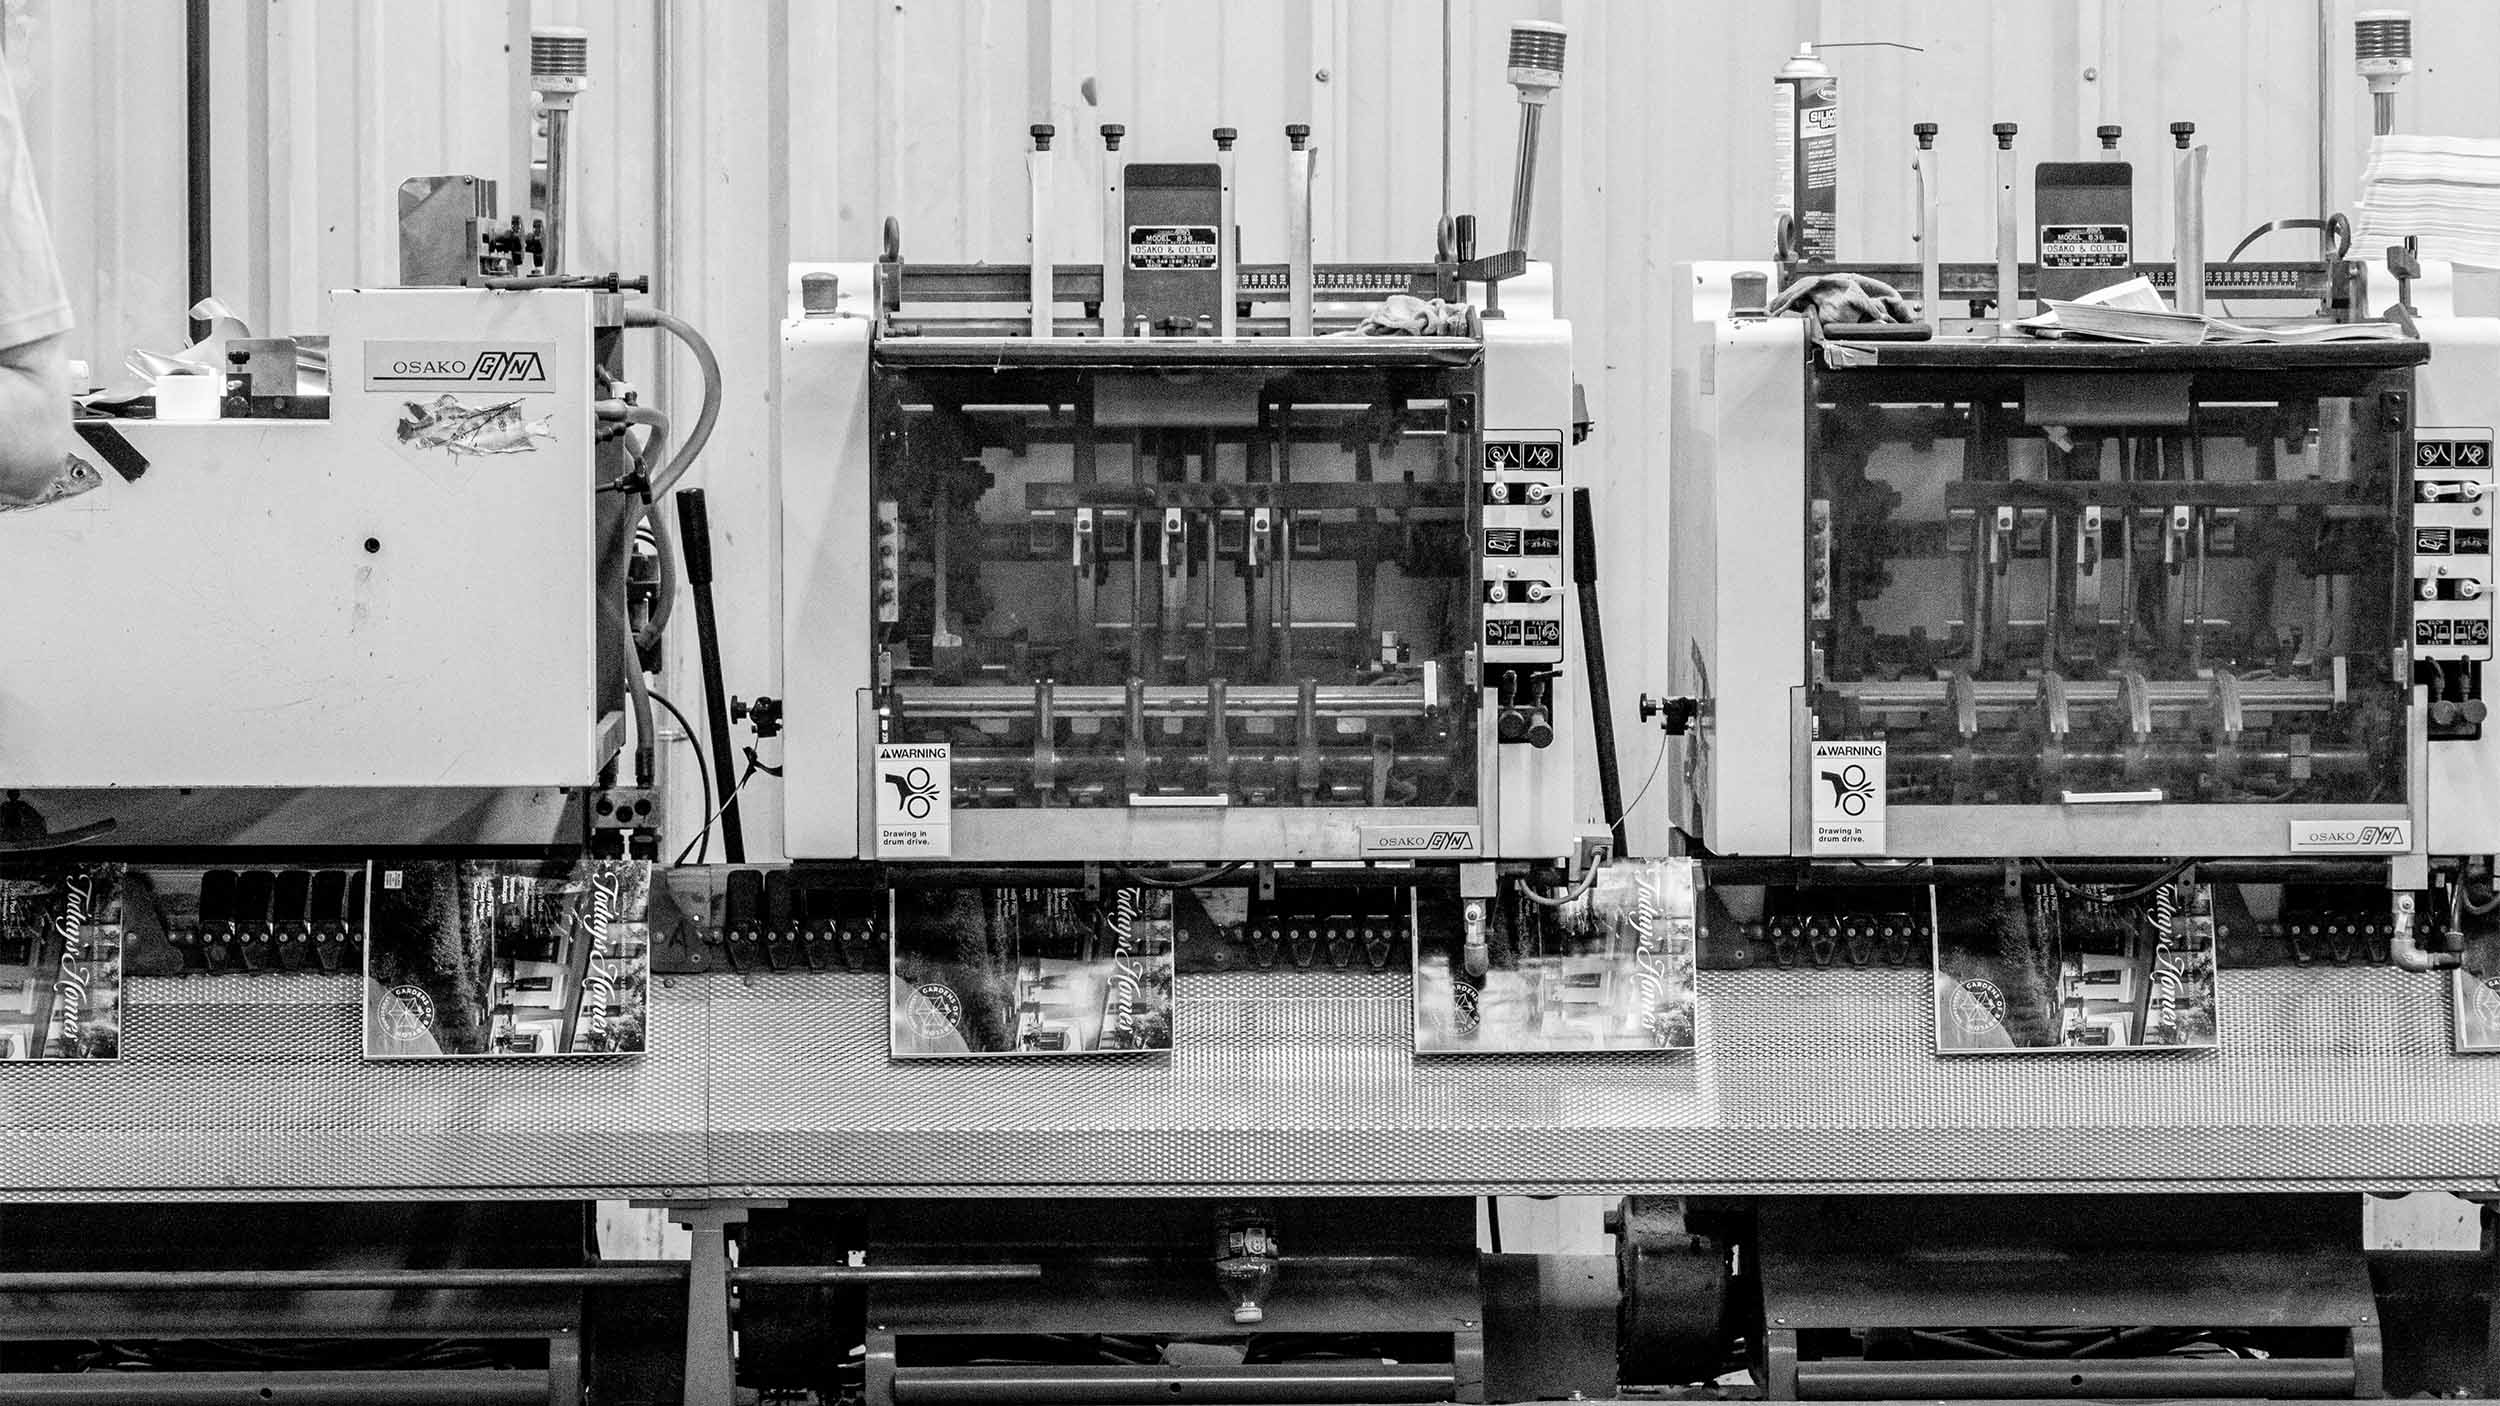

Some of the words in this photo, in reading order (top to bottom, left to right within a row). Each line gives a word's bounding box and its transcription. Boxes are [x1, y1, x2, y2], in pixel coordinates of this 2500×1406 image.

[393, 360, 466, 374] OSAKO
[891, 748, 946, 759] WARNING
[1827, 746, 1881, 756] WARNING
[1380, 838, 1425, 846] OSAKO
[2310, 832, 2355, 841] OSAKO
[56, 874, 92, 956] Today's
[584, 872, 619, 954] Today's
[582, 952, 618, 1036] Homes
[922, 986, 956, 1004] GARDENS
[1108, 949, 1143, 1033] Homes
[2151, 944, 2184, 1029] Homes
[54, 953, 90, 1042] Homes
[395, 988, 429, 1005] GARDENS
